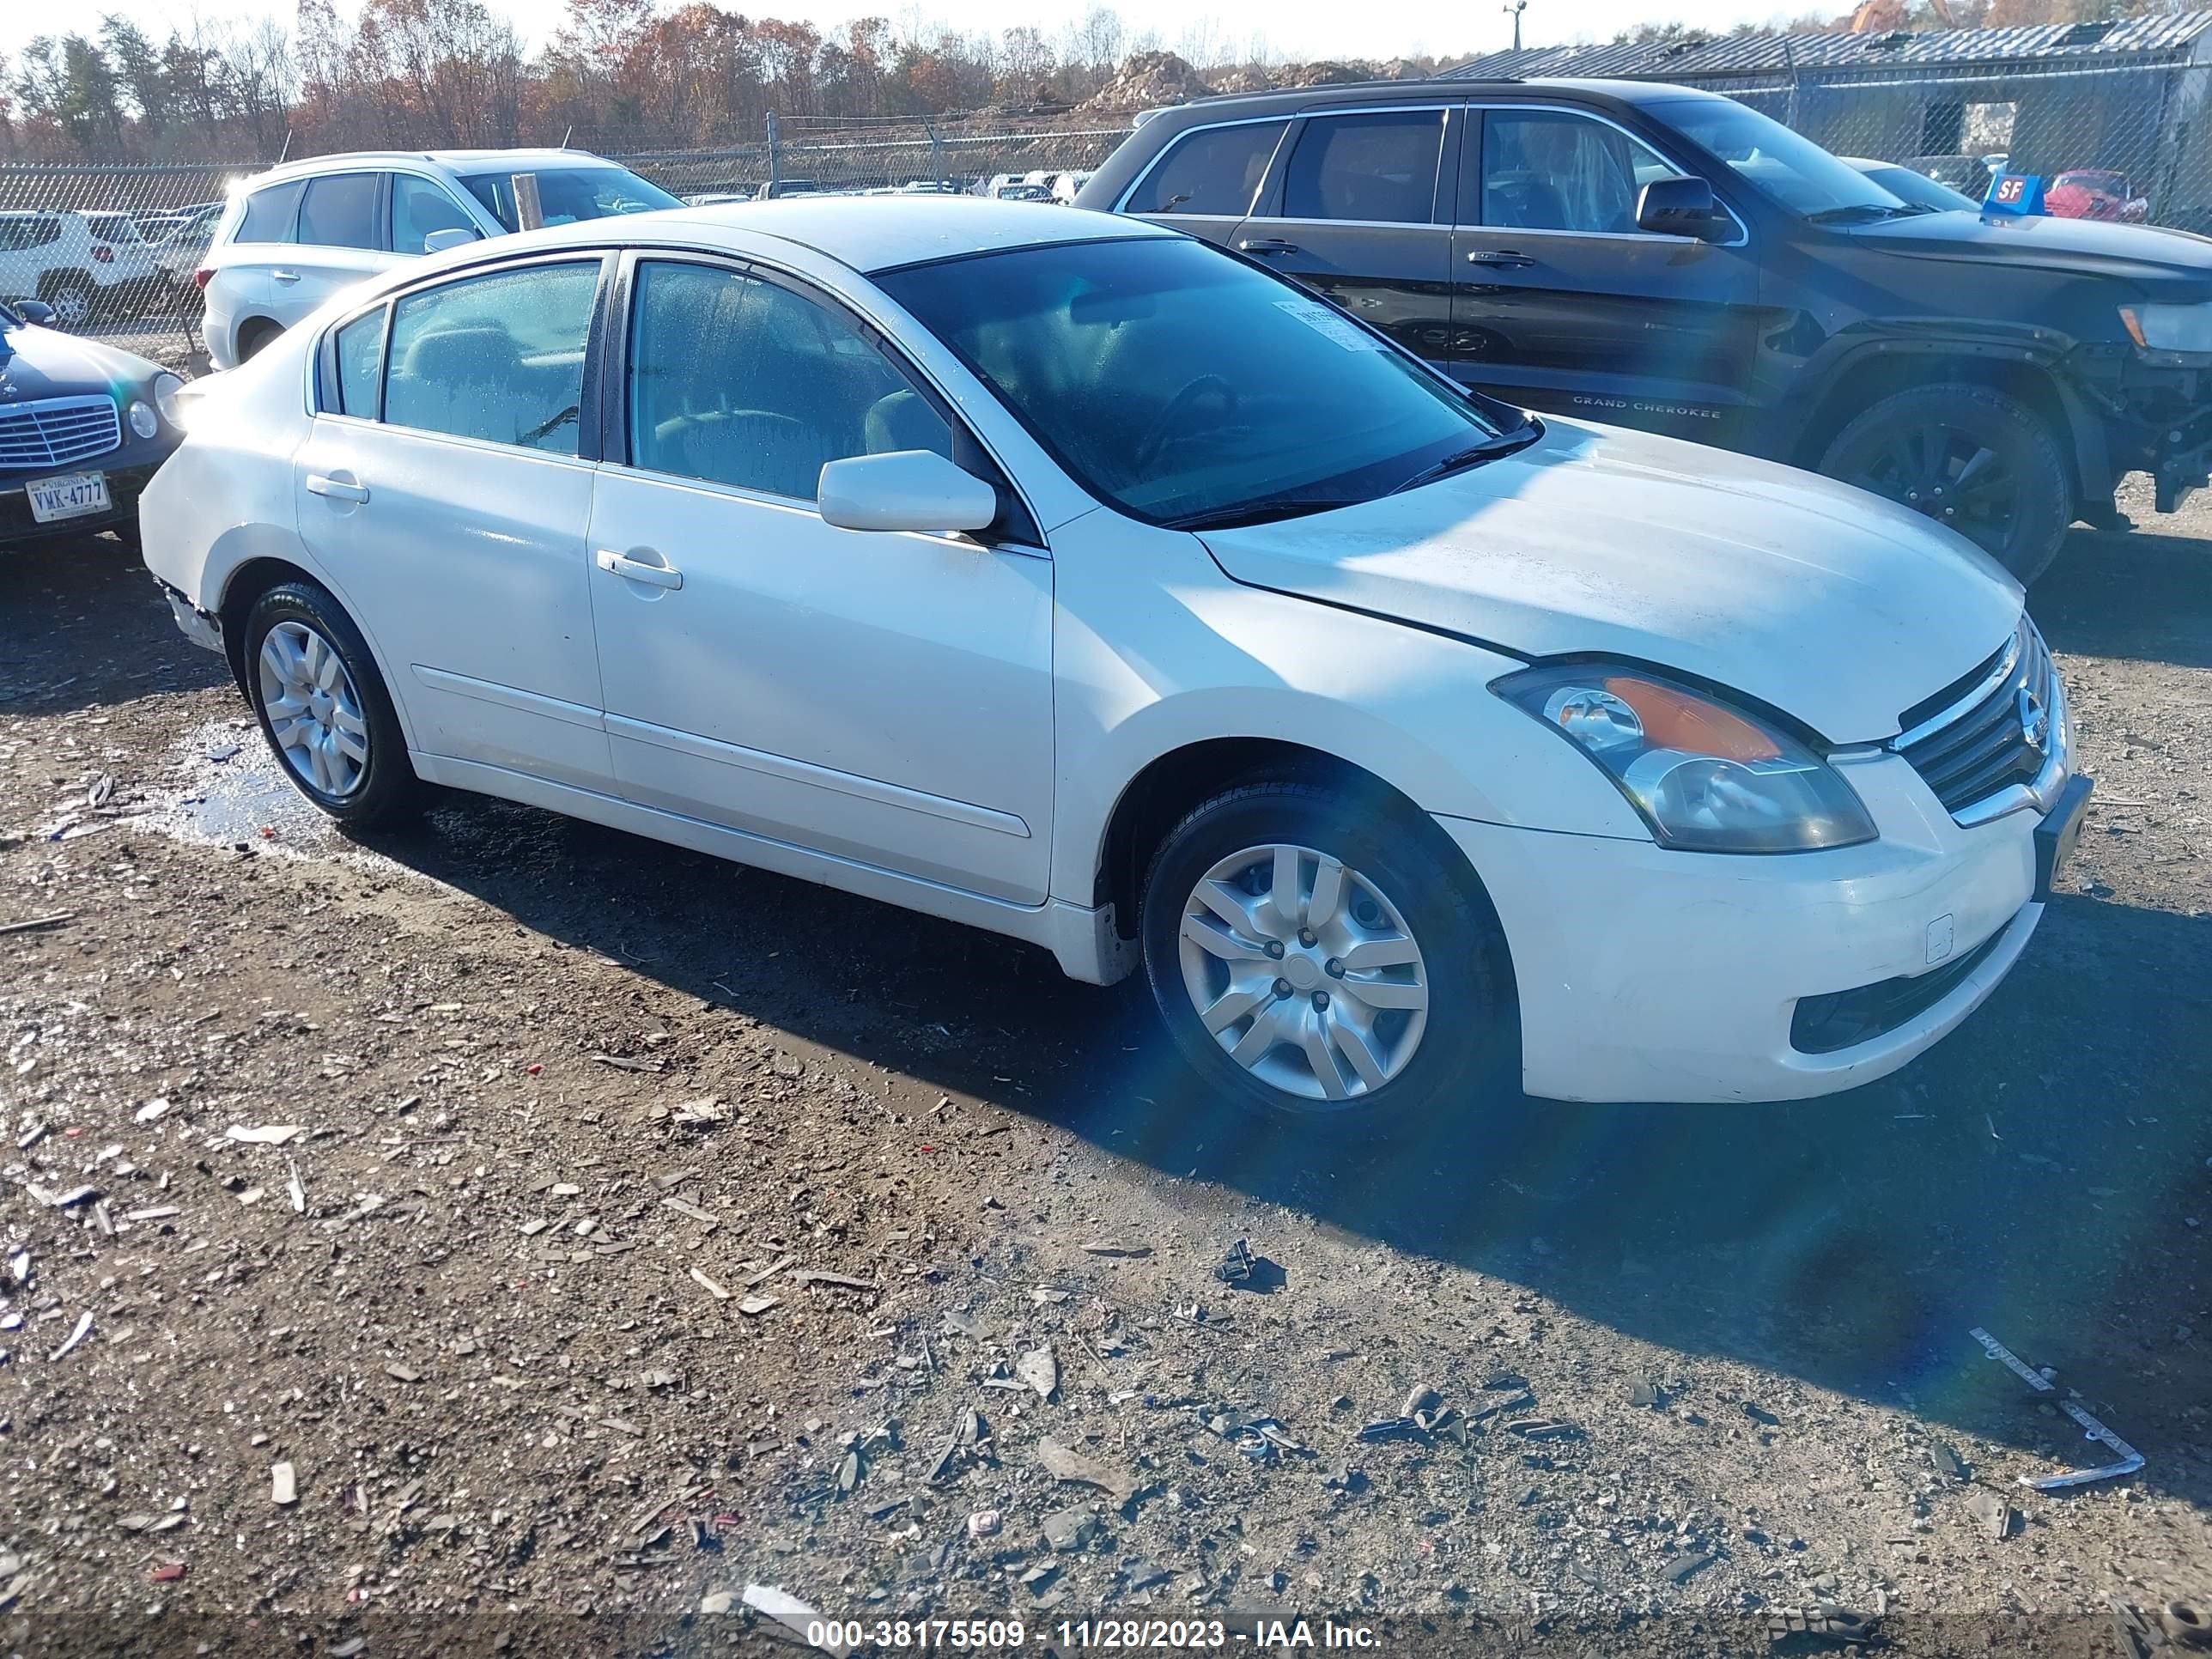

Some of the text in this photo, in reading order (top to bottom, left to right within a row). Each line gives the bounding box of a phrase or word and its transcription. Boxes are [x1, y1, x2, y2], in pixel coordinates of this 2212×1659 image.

[1998, 180, 2024, 199] SF
[1573, 396, 1722, 419] GRAND CHEROKEE
[48, 477, 85, 489] VIRGINIA
[34, 483, 101, 511] VMK-4777
